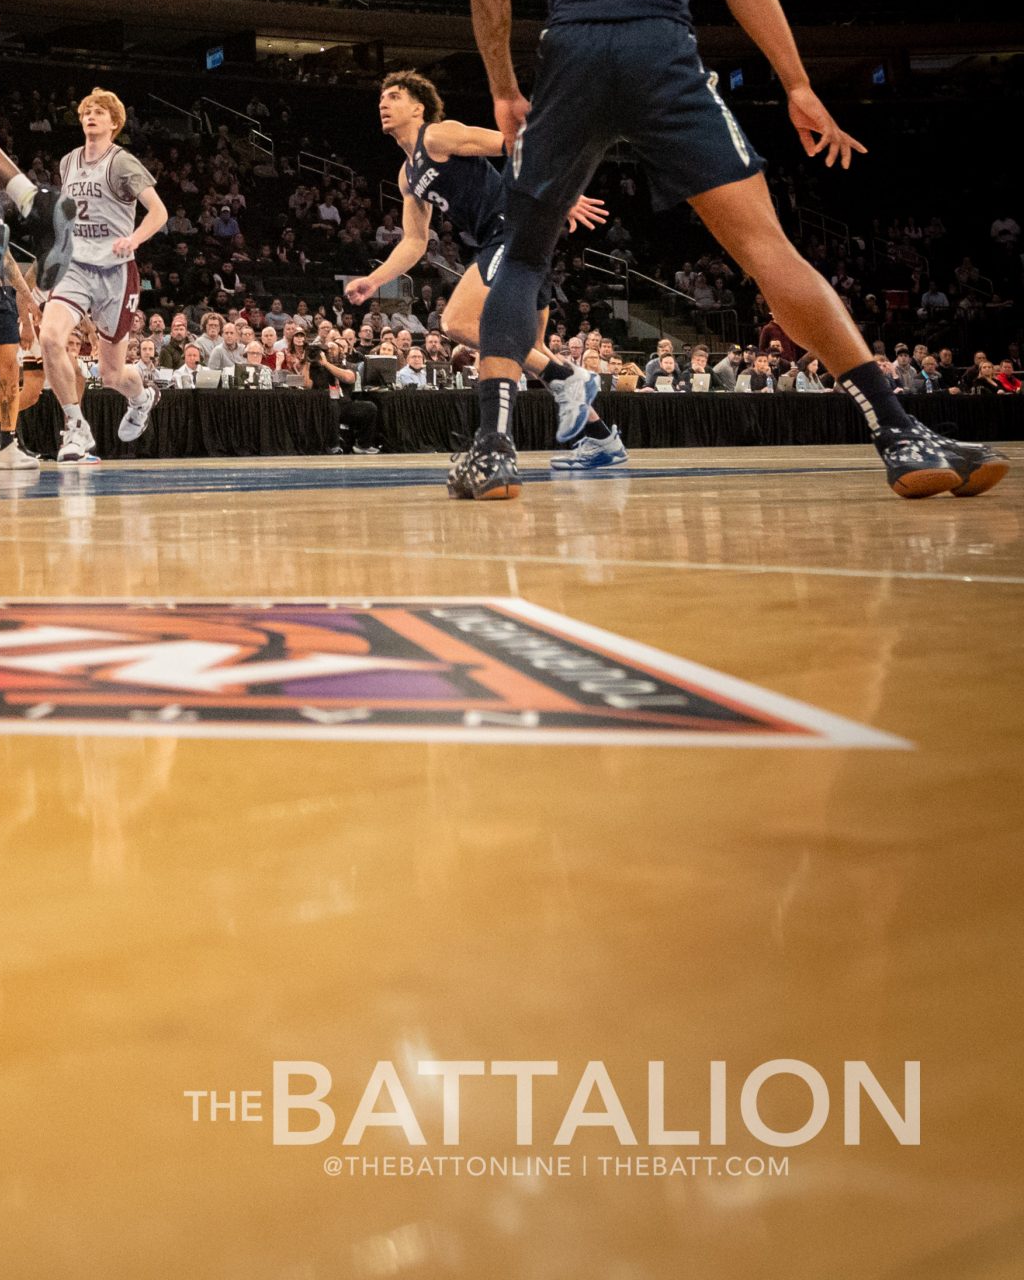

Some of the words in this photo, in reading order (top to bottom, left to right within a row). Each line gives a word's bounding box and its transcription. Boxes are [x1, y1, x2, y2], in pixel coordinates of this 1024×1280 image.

[67, 182, 102, 198] TEXAS
[77, 200, 89, 220] 2
[72, 223, 109, 238] GGIES
